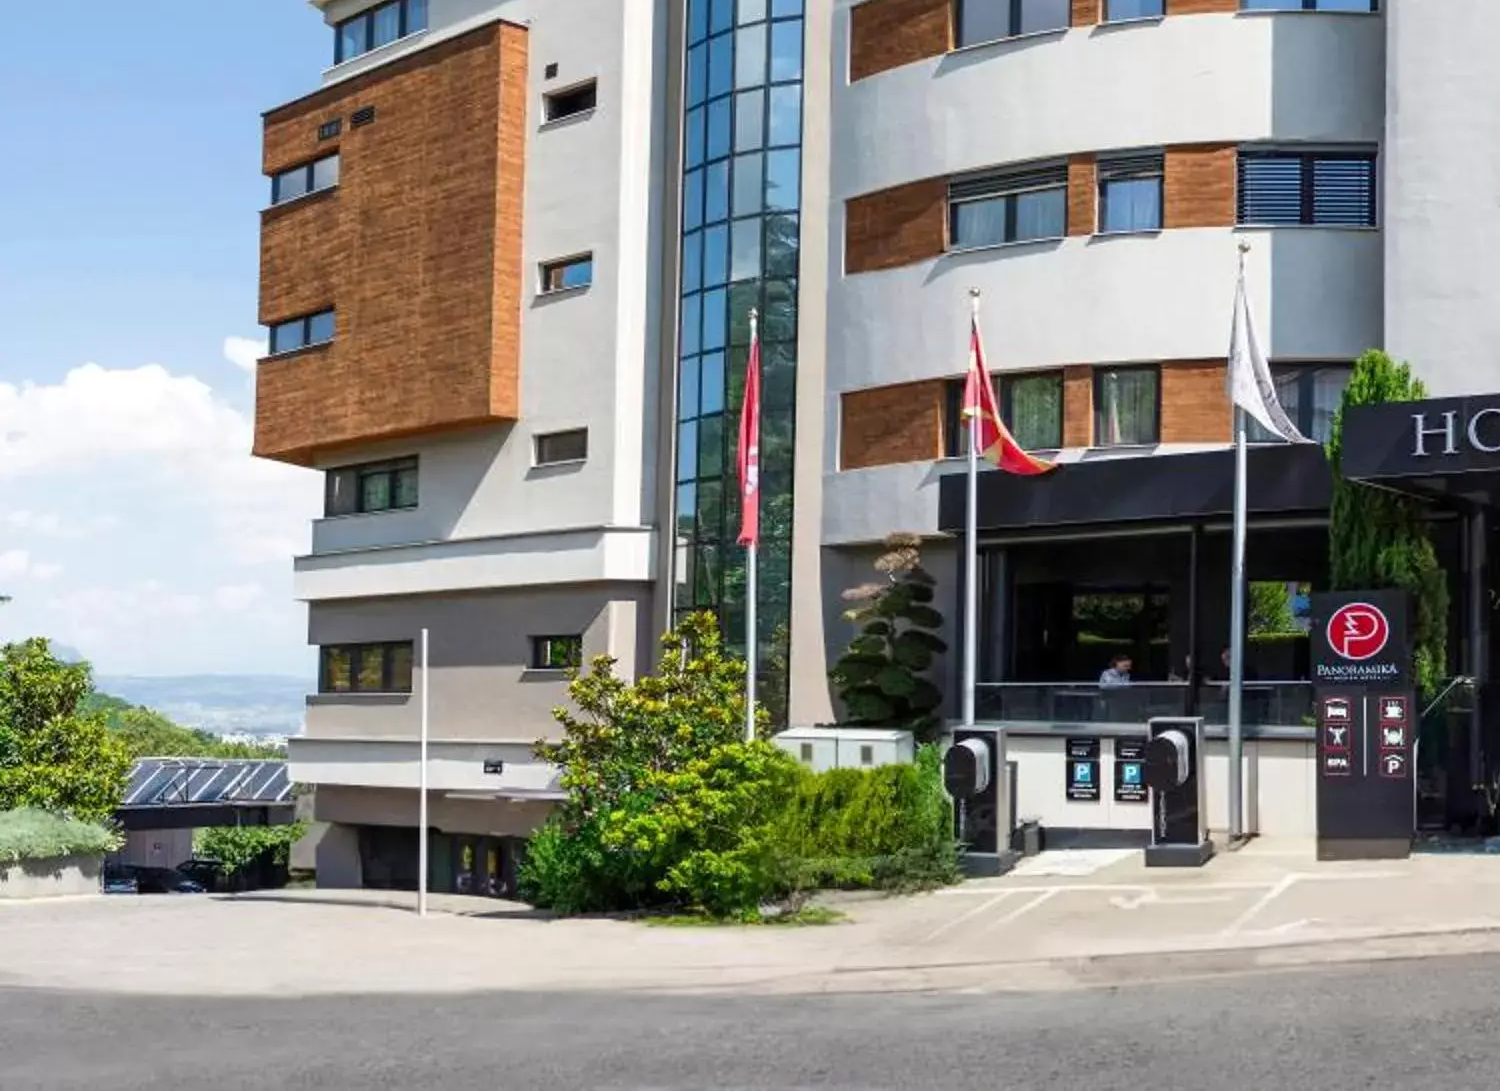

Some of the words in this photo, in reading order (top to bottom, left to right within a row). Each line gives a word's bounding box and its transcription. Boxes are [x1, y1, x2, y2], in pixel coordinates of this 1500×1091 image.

[1317, 663, 1398, 675] PANORAMIKA
[1076, 765, 1088, 780] P
[1125, 765, 1137, 782] P
[1388, 760, 1400, 774] P
